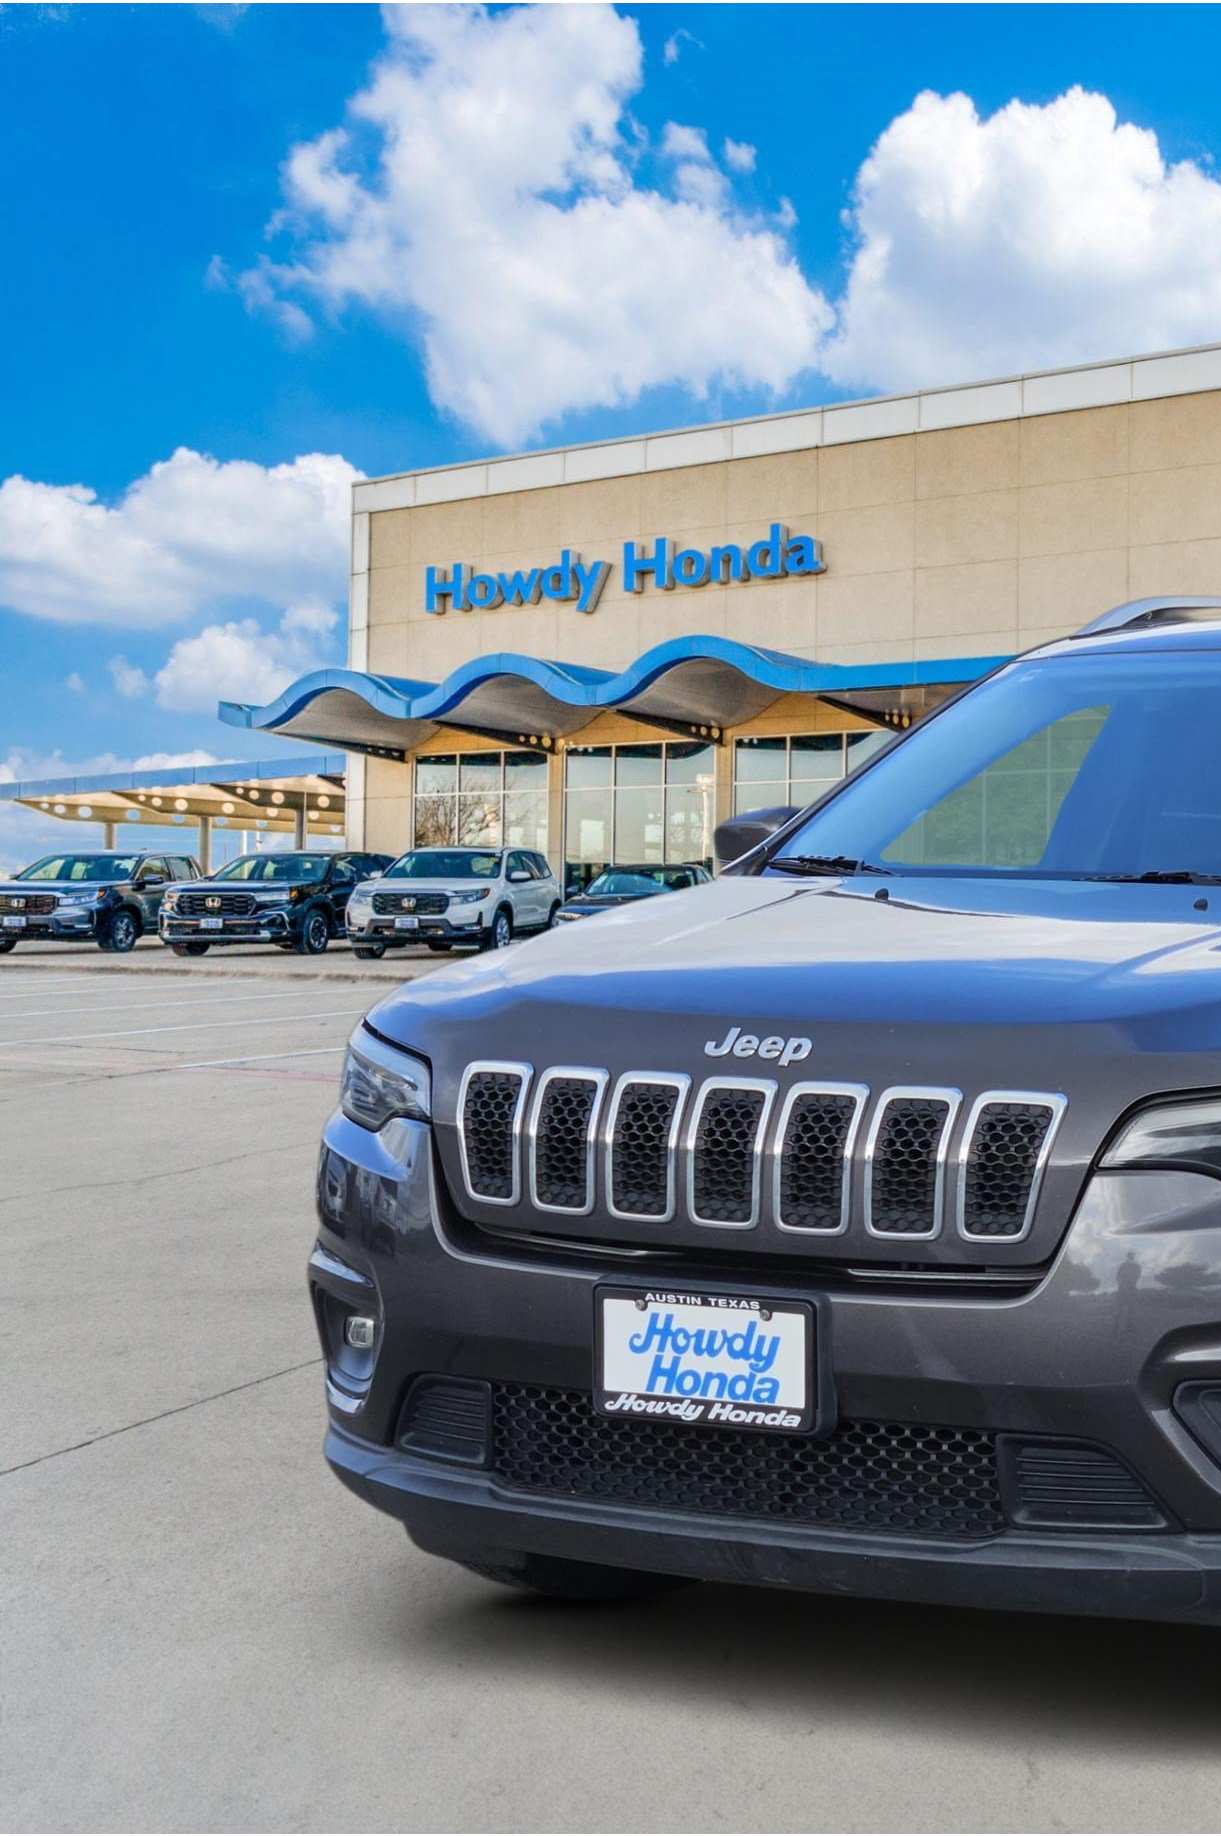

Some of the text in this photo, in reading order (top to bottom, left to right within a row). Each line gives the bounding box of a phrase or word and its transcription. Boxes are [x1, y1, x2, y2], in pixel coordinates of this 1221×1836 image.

[425, 523, 827, 615] Howdy Honda
[704, 1027, 813, 1067] Jeep
[645, 1292, 761, 1311] AUSTIN TEXAS
[628, 1312, 782, 1373] Howdy
[645, 1354, 781, 1405] Honda
[604, 1393, 801, 1428] Howdy Honda
